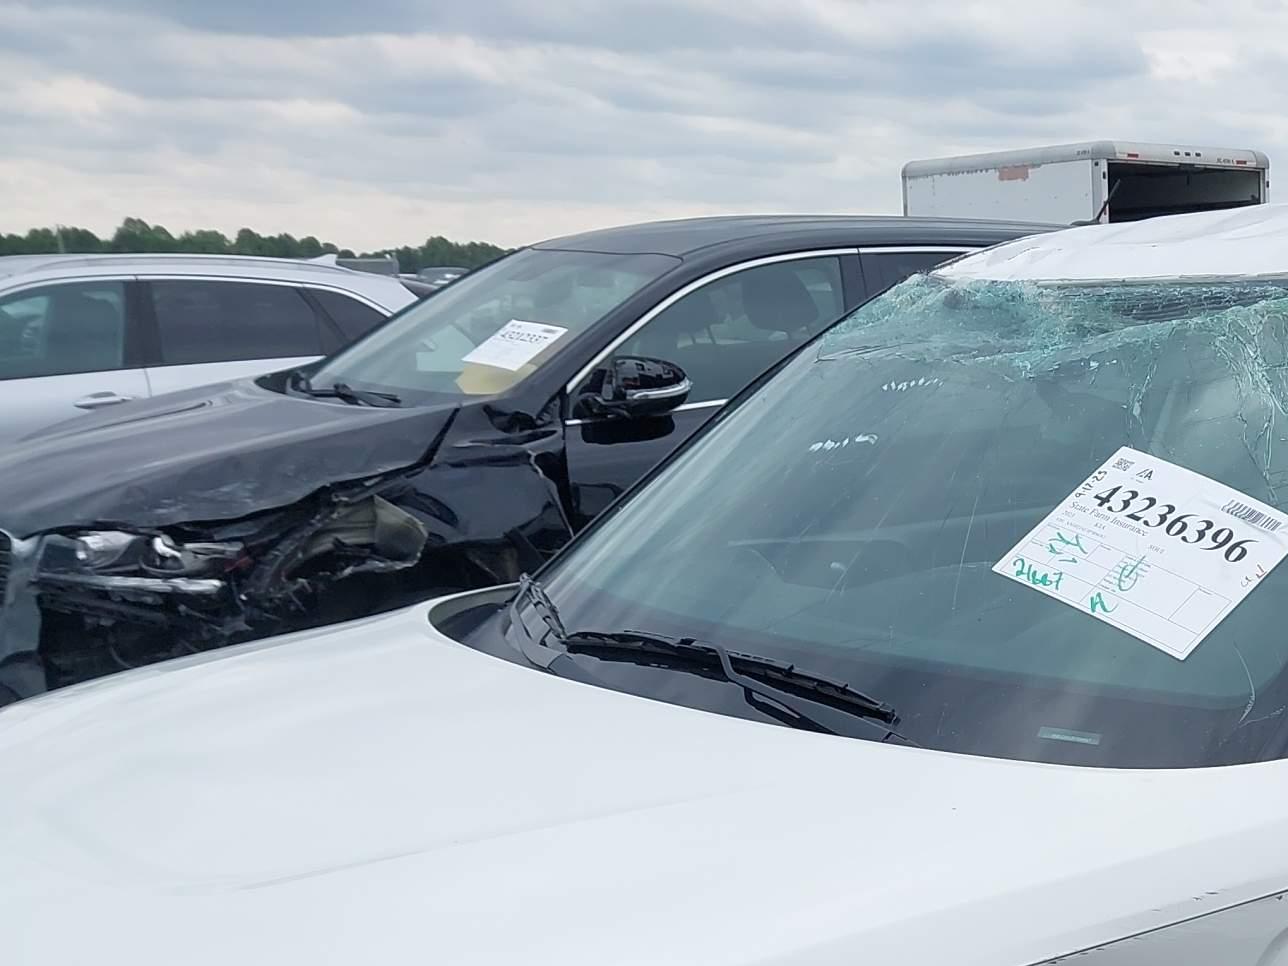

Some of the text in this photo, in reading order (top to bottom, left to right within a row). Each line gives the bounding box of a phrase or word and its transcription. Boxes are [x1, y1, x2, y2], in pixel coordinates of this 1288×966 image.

[1071, 501, 1090, 514] State
[1090, 508, 1111, 521] Farm
[1110, 516, 1149, 537] Insurance
[1093, 485, 1260, 563] 43236396
